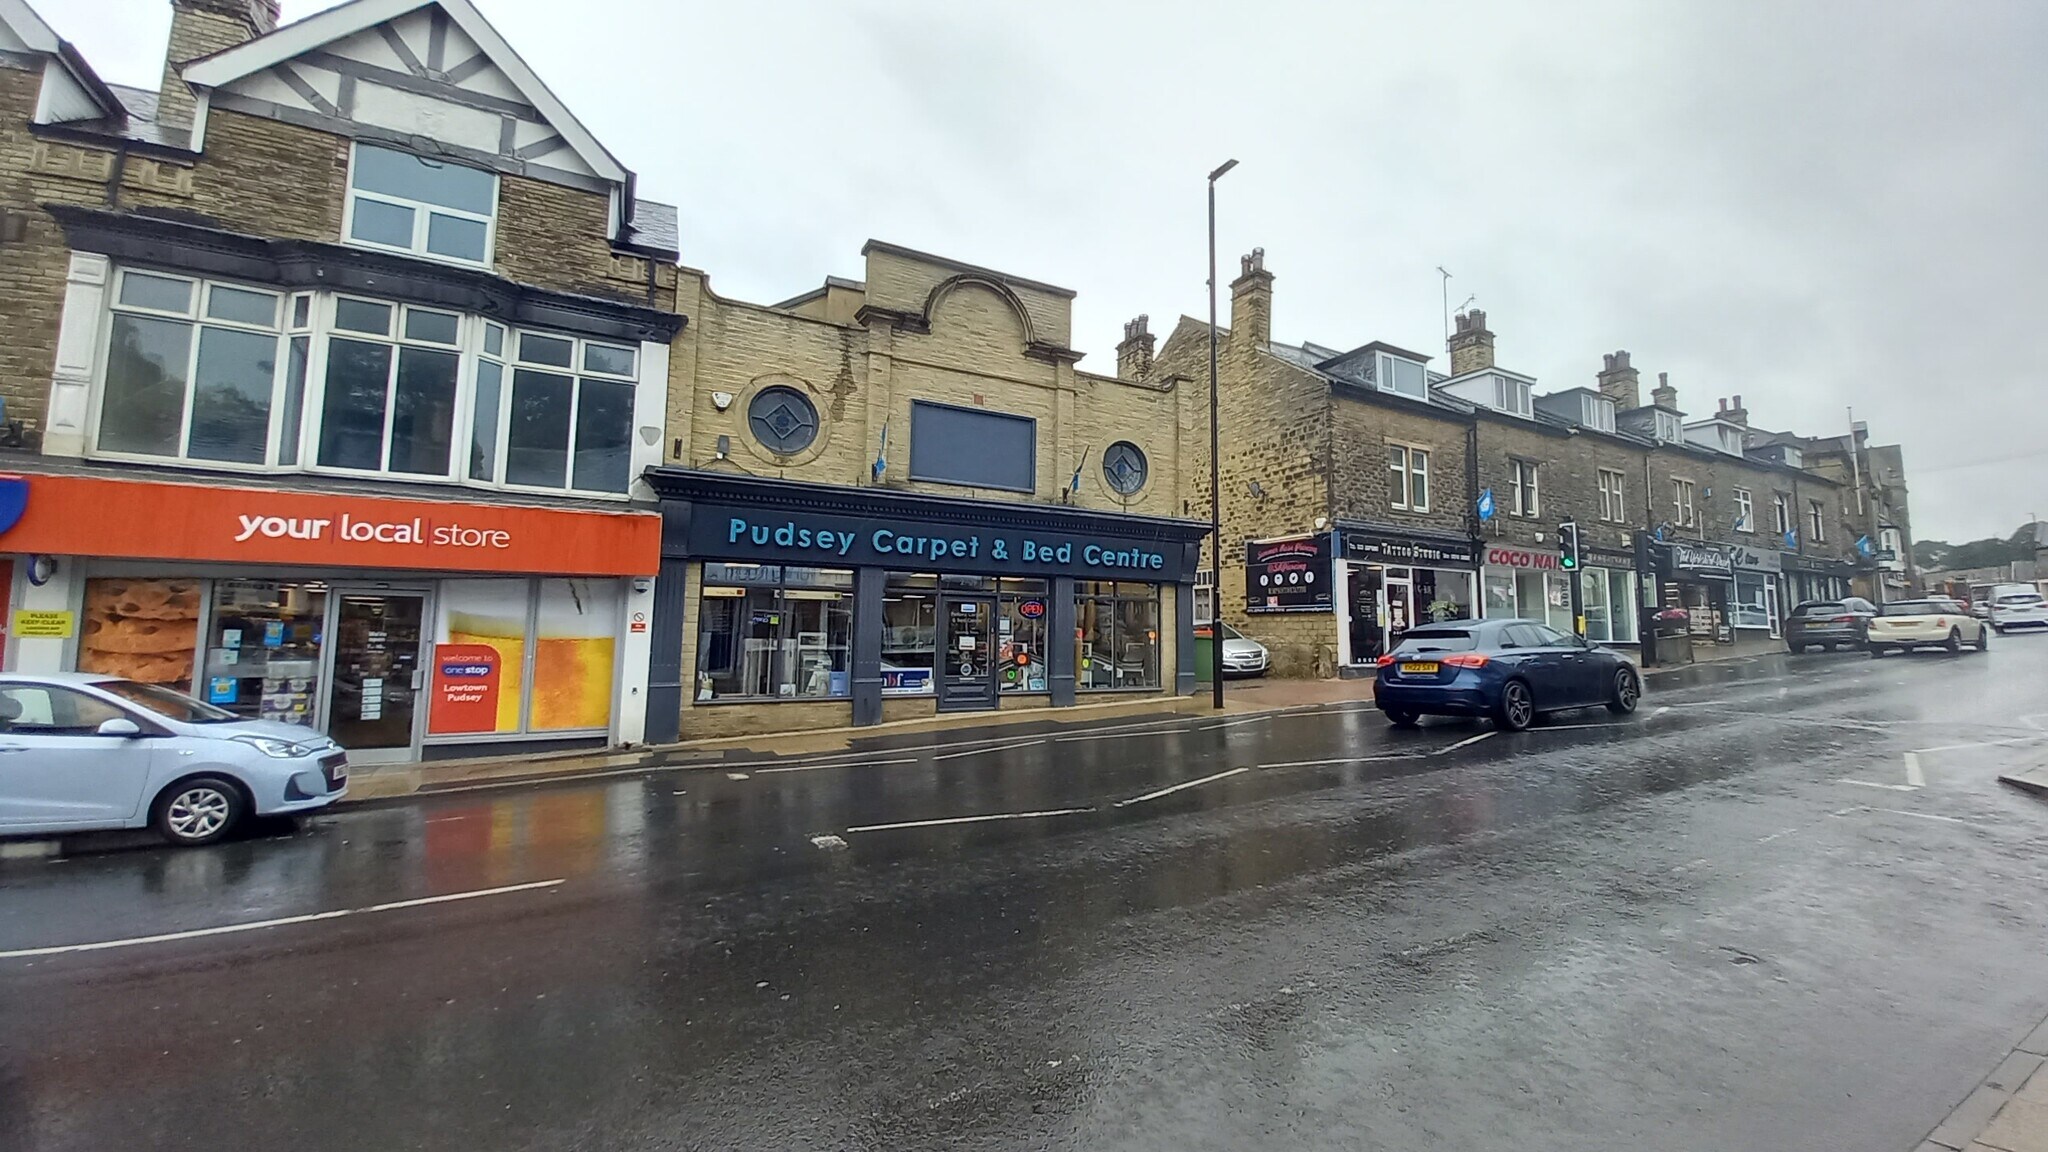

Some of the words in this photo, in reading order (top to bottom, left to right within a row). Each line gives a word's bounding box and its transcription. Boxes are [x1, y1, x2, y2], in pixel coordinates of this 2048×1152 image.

[234, 514, 330, 542] your
[341, 513, 423, 544] local
[433, 523, 511, 548] store
[729, 518, 856, 556] Pudsey
[872, 529, 980, 561] Carpet
[991, 539, 1009, 560] &
[1022, 540, 1072, 564] Bed
[1083, 545, 1164, 569] Centre
[1489, 549, 1530, 567] COCO
[1020, 604, 1043, 614] OPEN
[442, 654, 482, 662] welcome
[464, 666, 489, 675] stop
[443, 684, 488, 692] Lowtown
[447, 693, 483, 703] Pudsey
